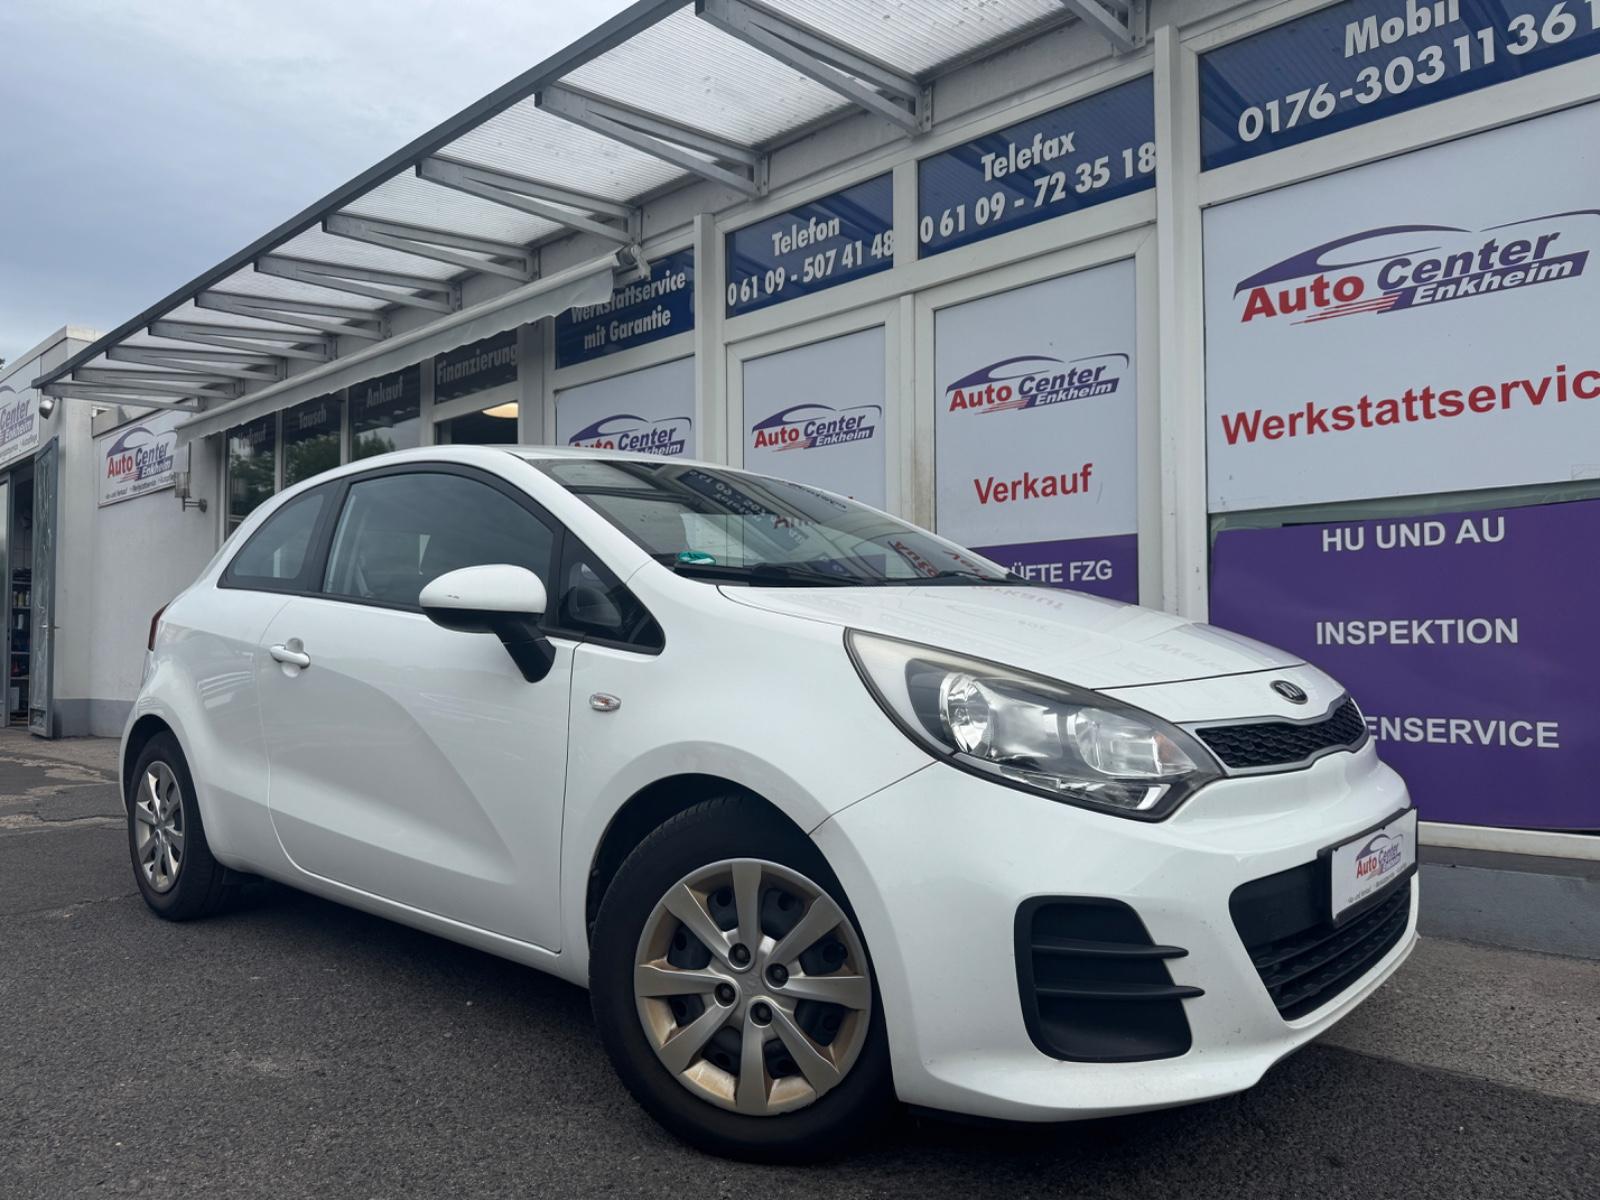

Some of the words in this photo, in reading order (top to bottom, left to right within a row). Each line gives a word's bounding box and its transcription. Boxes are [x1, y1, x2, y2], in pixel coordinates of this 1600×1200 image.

[1344, 0, 1460, 58] Mobil
[981, 131, 1077, 182] Telefax
[940, 204, 966, 237] 61
[975, 191, 1006, 226] 09
[1033, 171, 1066, 208] 72
[1075, 155, 1111, 194] 35
[1122, 141, 1156, 179] 18
[771, 216, 840, 256] Telefon
[740, 275, 758, 302] 61
[765, 266, 786, 294] 09
[802, 248, 837, 282] 507
[842, 240, 863, 269] 41
[871, 229, 894, 259] 48
[1240, 273, 1365, 323] Auto
[1376, 231, 1561, 291] Center
[1411, 260, 1576, 305] Enkheim
[584, 324, 606, 350] mit
[609, 305, 672, 342] Garantie
[437, 342, 518, 385] Finanzierung
[367, 376, 404, 409] Ankauf
[949, 384, 1013, 412] Auto
[1018, 365, 1107, 397] Center
[1034, 382, 1114, 406] Enkheim
[1221, 364, 1600, 446] Werkstattservic
[299, 404, 327, 430] Tausch
[754, 427, 800, 449] Auto
[804, 415, 866, 438] Center
[618, 427, 677, 451] Center
[816, 430, 871, 446] Enkheim
[107, 454, 133, 478] Auto
[135, 442, 169, 467] Center
[973, 463, 1093, 505] Verkauf
[1321, 527, 1364, 552] HU
[1376, 521, 1446, 549] UND
[1455, 516, 1505, 545] AU
[1069, 559, 1113, 582] FZG
[1315, 617, 1519, 645] INSPEKTION
[1357, 857, 1377, 879] Auto
